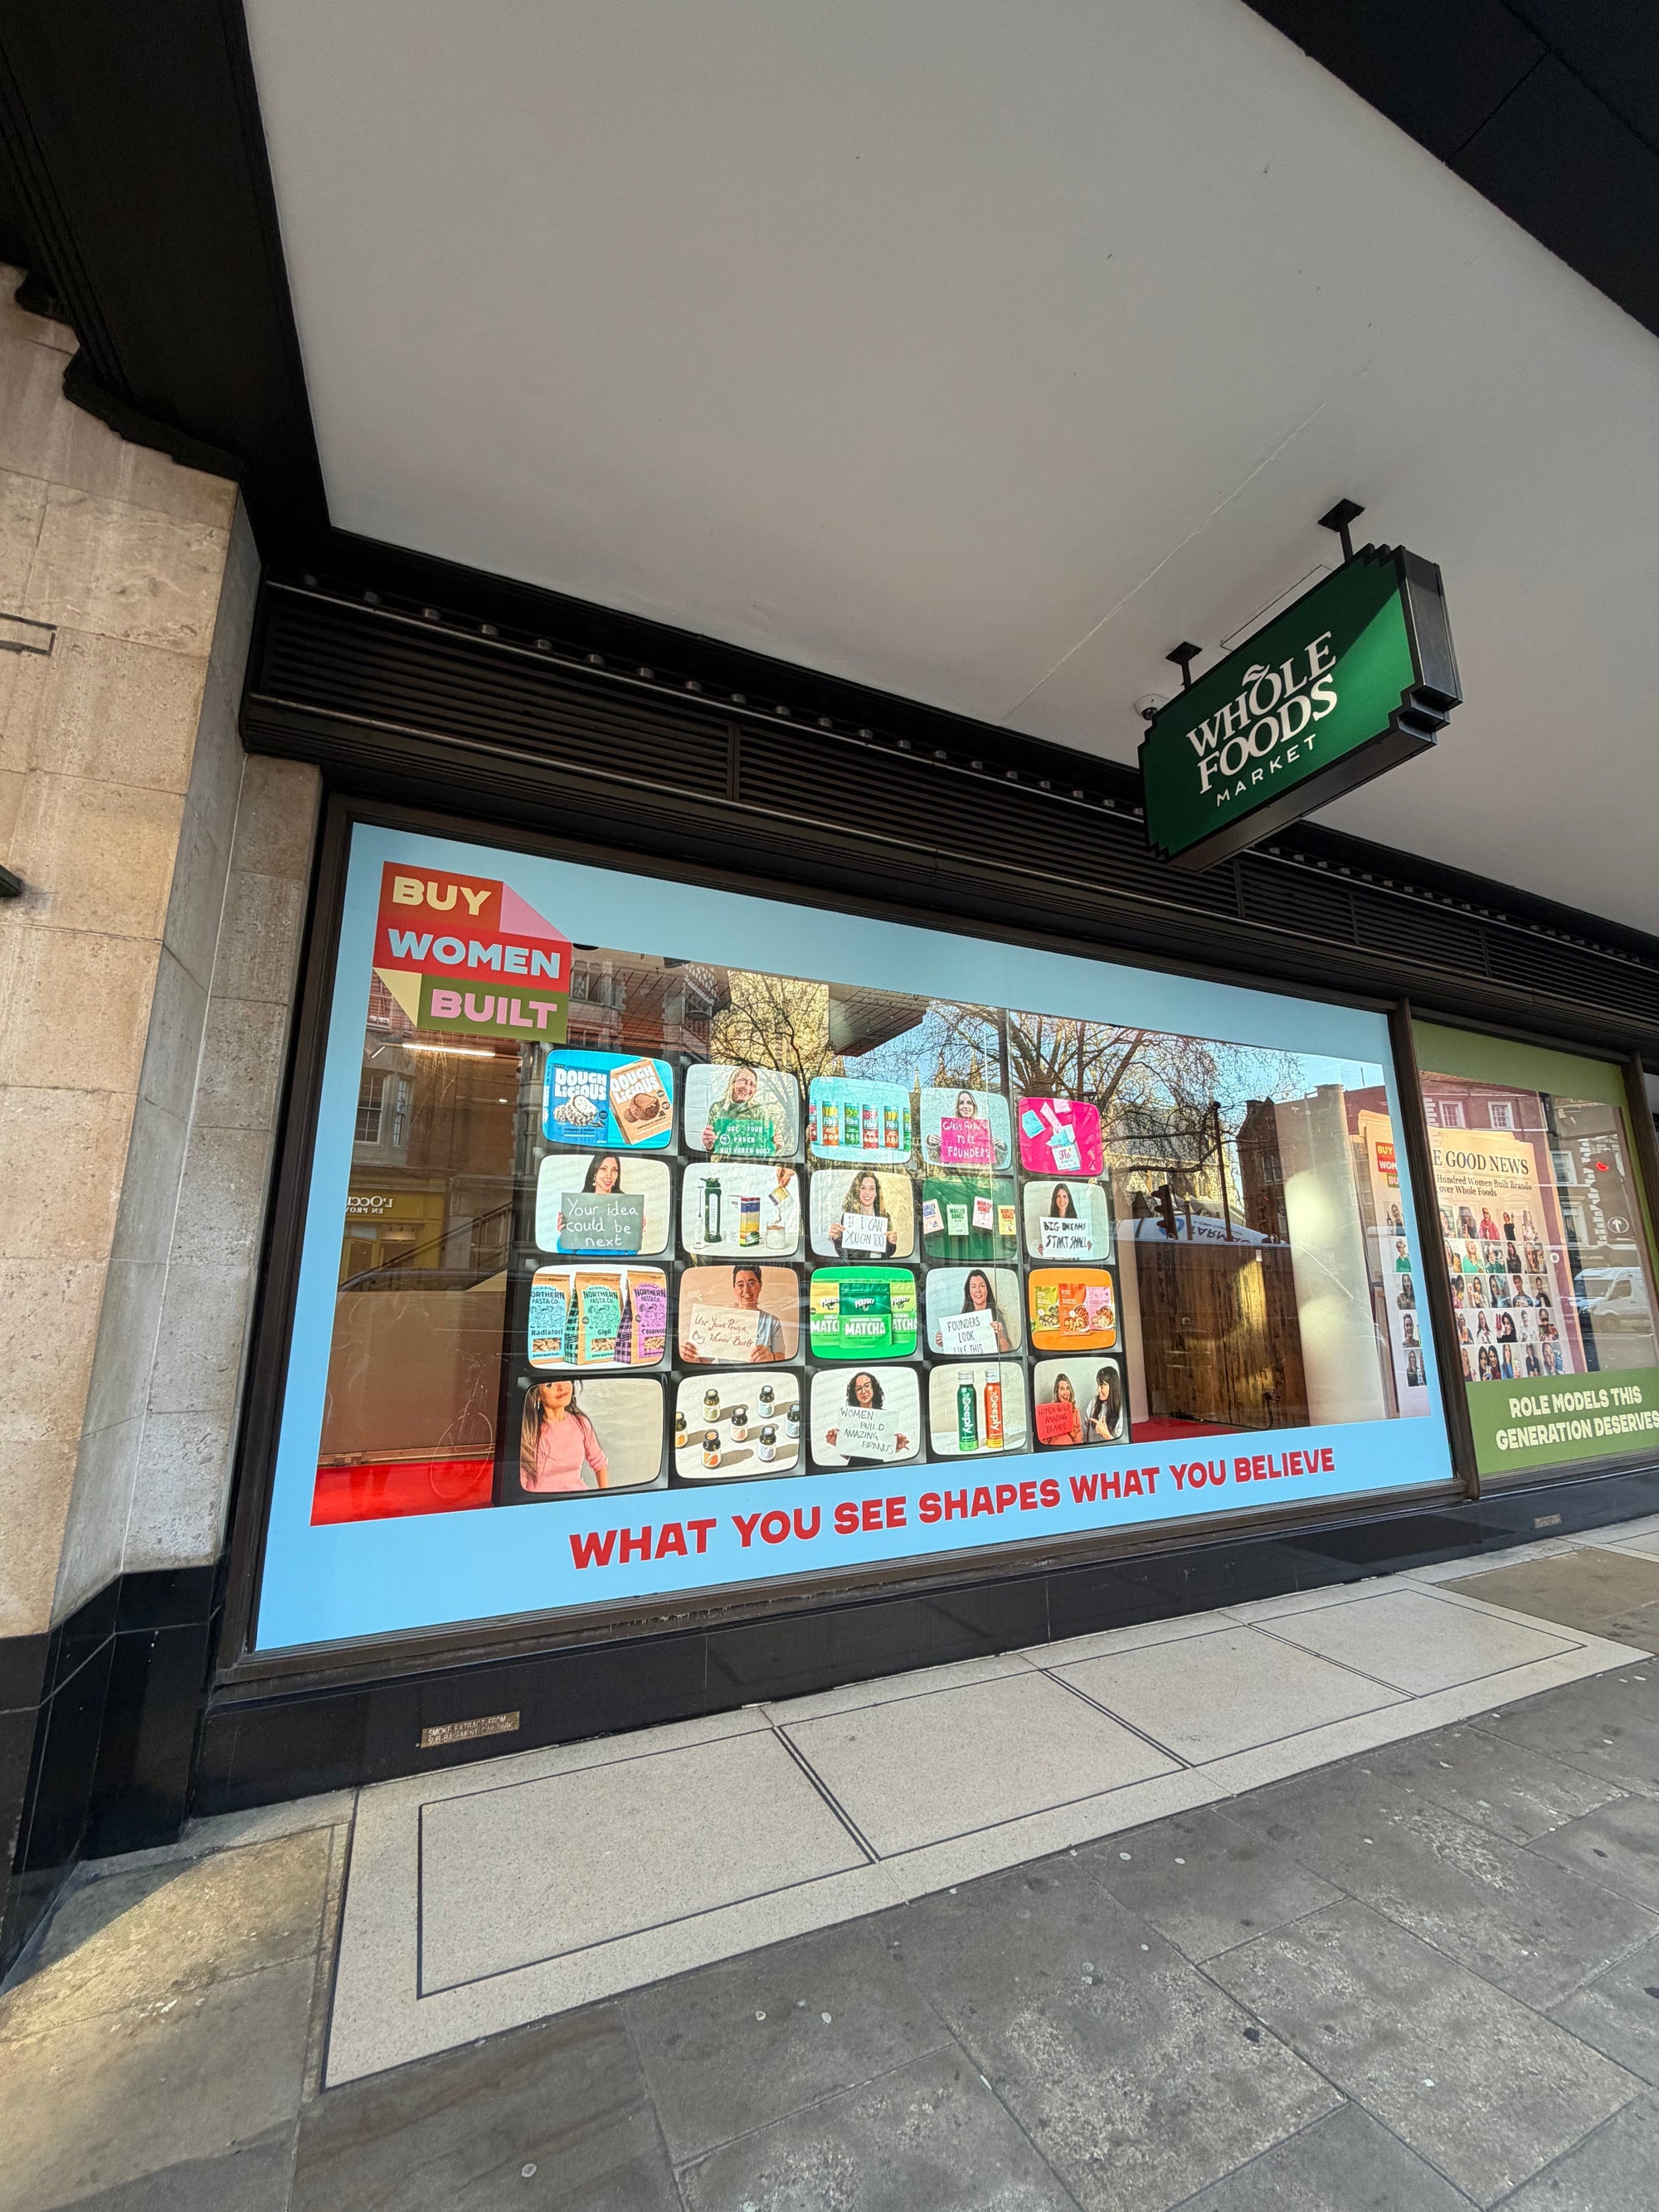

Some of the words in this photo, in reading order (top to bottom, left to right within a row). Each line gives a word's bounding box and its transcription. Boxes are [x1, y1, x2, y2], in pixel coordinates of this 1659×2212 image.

[1185, 631, 1336, 758] WHOLE
[1198, 673, 1338, 795] FOODS
[1216, 733, 1316, 806] MARKET
[392, 876, 492, 916] BUY
[387, 928, 561, 980] WOMEN
[431, 989, 557, 1029] BUILT
[555, 1067, 607, 1087] DOUGH
[611, 1065, 655, 1092] DOUGH
[947, 1146, 990, 1159] FOUNDERS
[1378, 1146, 1394, 1155] BUY
[1445, 1150, 1486, 1170] GOOD
[1490, 1156, 1530, 1174] NEWS
[1437, 1174, 1467, 1184] Hundred
[1467, 1176, 1493, 1187] Women
[1493, 1178, 1509, 1189] Built
[1510, 1181, 1532, 1190] Brands
[1455, 1186, 1477, 1195] Whole
[1477, 1187, 1497, 1197] Foods
[567, 1198, 599, 1216] Your
[607, 1200, 639, 1216] idea
[566, 1217, 606, 1232] could
[615, 1219, 631, 1233] be
[868, 1218, 883, 1232] CAN
[1044, 1222, 1060, 1231] BIG
[1062, 1223, 1087, 1231] DREAMS
[585, 1234, 622, 1247] next
[873, 1233, 884, 1247] TOO
[1046, 1235, 1069, 1249] START
[531, 1291, 566, 1300] ORTHERN
[583, 1291, 619, 1300] NORTHERN
[634, 1288, 666, 1298] NORTHERN
[844, 1322, 886, 1336] MATCHA
[892, 1318, 917, 1331] ATCHA
[947, 1316, 980, 1332] FOUNDERS
[958, 1330, 975, 1344] LOOK
[969, 1344, 984, 1354] THIS
[1509, 1395, 1551, 1418] ROLE
[1551, 1389, 1610, 1413] MODELS
[1610, 1385, 1642, 1406] THIS
[840, 1407, 874, 1421] WOMEN
[961, 1396, 974, 1434] Deeply
[990, 1395, 1001, 1431] Deeply
[844, 1428, 878, 1441] AMAZING
[860, 1422, 885, 1431] BUILD
[1496, 1418, 1593, 1451] GENERATION
[1593, 1410, 1659, 1437] DESERVES
[568, 1518, 717, 1571] WHAT
[731, 1505, 821, 1548] YOU
[833, 1495, 907, 1535] SEE
[918, 1478, 1061, 1524] SHAPES
[1068, 1466, 1160, 1504] WHAT
[1168, 1459, 1227, 1491] YOU
[1233, 1447, 1335, 1483] BELIEVE
[428, 1726, 452, 1738] SMOKE
[455, 1719, 484, 1731] EXTRACT
[488, 1715, 507, 1724] FROM
[427, 1736, 441, 1745] SUB
[443, 1728, 479, 1743] BASEMENT
